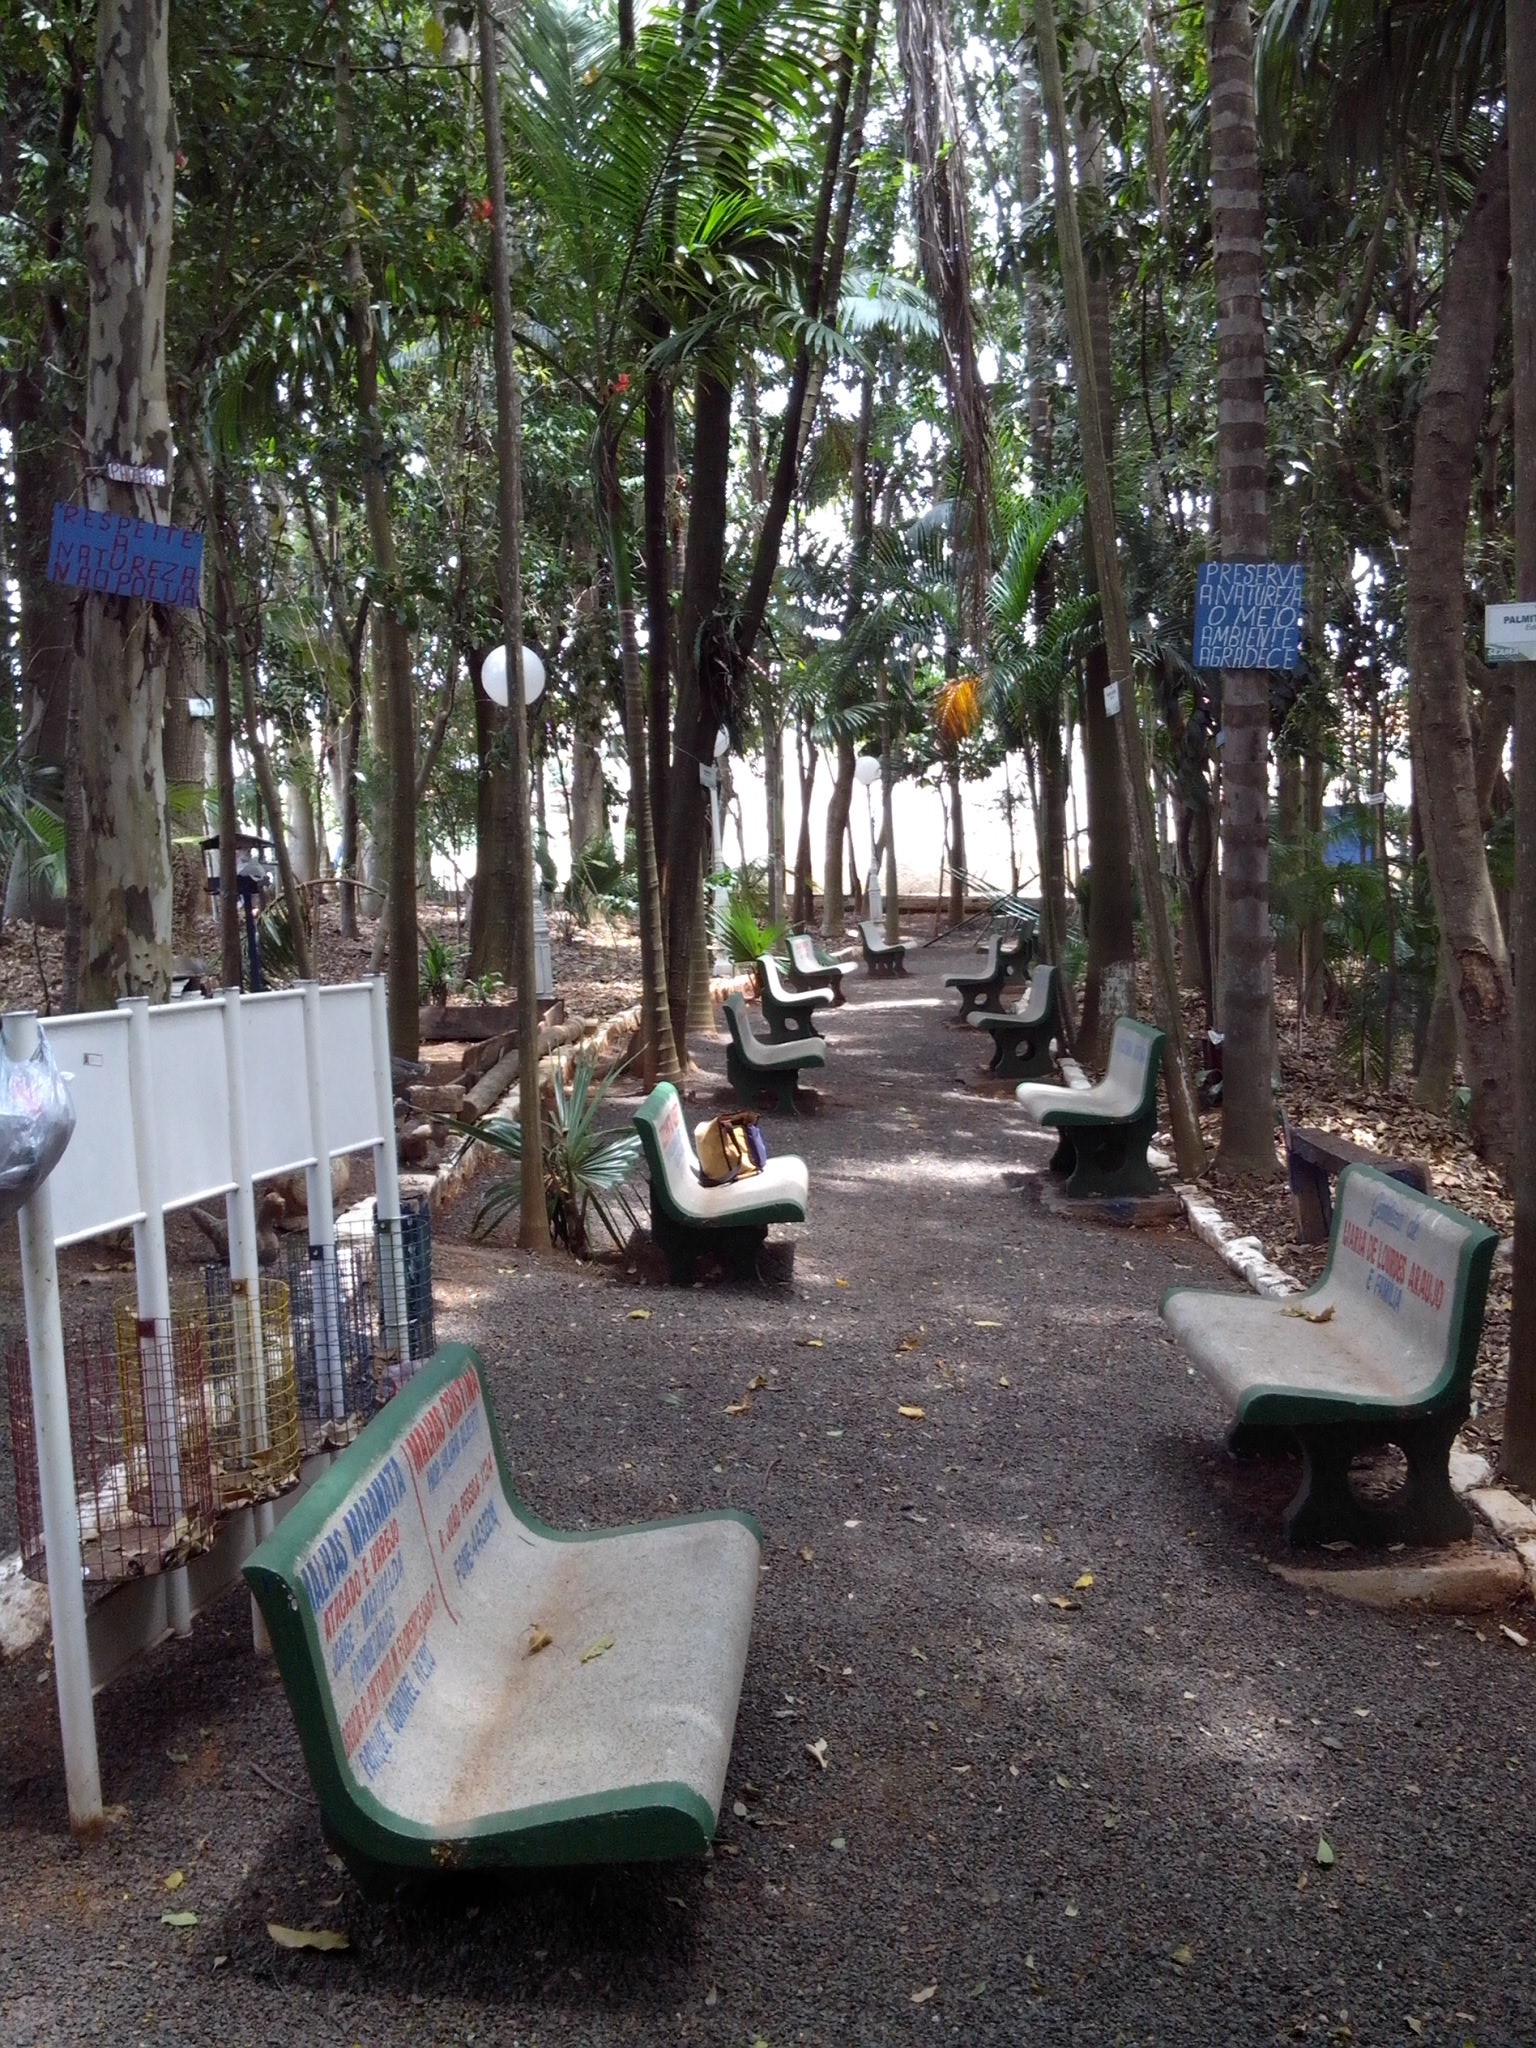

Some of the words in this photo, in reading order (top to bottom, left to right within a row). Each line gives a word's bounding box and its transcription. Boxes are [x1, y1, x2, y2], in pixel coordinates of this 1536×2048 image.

[63, 505, 195, 549] RESPEITE
[113, 534, 128, 553] A
[56, 541, 197, 588] NATUREZA
[1205, 563, 1302, 587] PRESERVE
[115, 572, 197, 609] POLUA
[1199, 584, 1213, 605] A
[1215, 584, 1303, 608] NATUREZA
[1207, 606, 1226, 626] O
[1233, 606, 1296, 629] MEIO
[1200, 625, 1296, 649] AMBIENTE
[1199, 647, 1296, 670] AGRADECE
[342, 1455, 407, 1556] MARANATA
[323, 1568, 362, 1644] ATACADO
[361, 1556, 370, 1587] E
[369, 1517, 401, 1575] VAREJO
